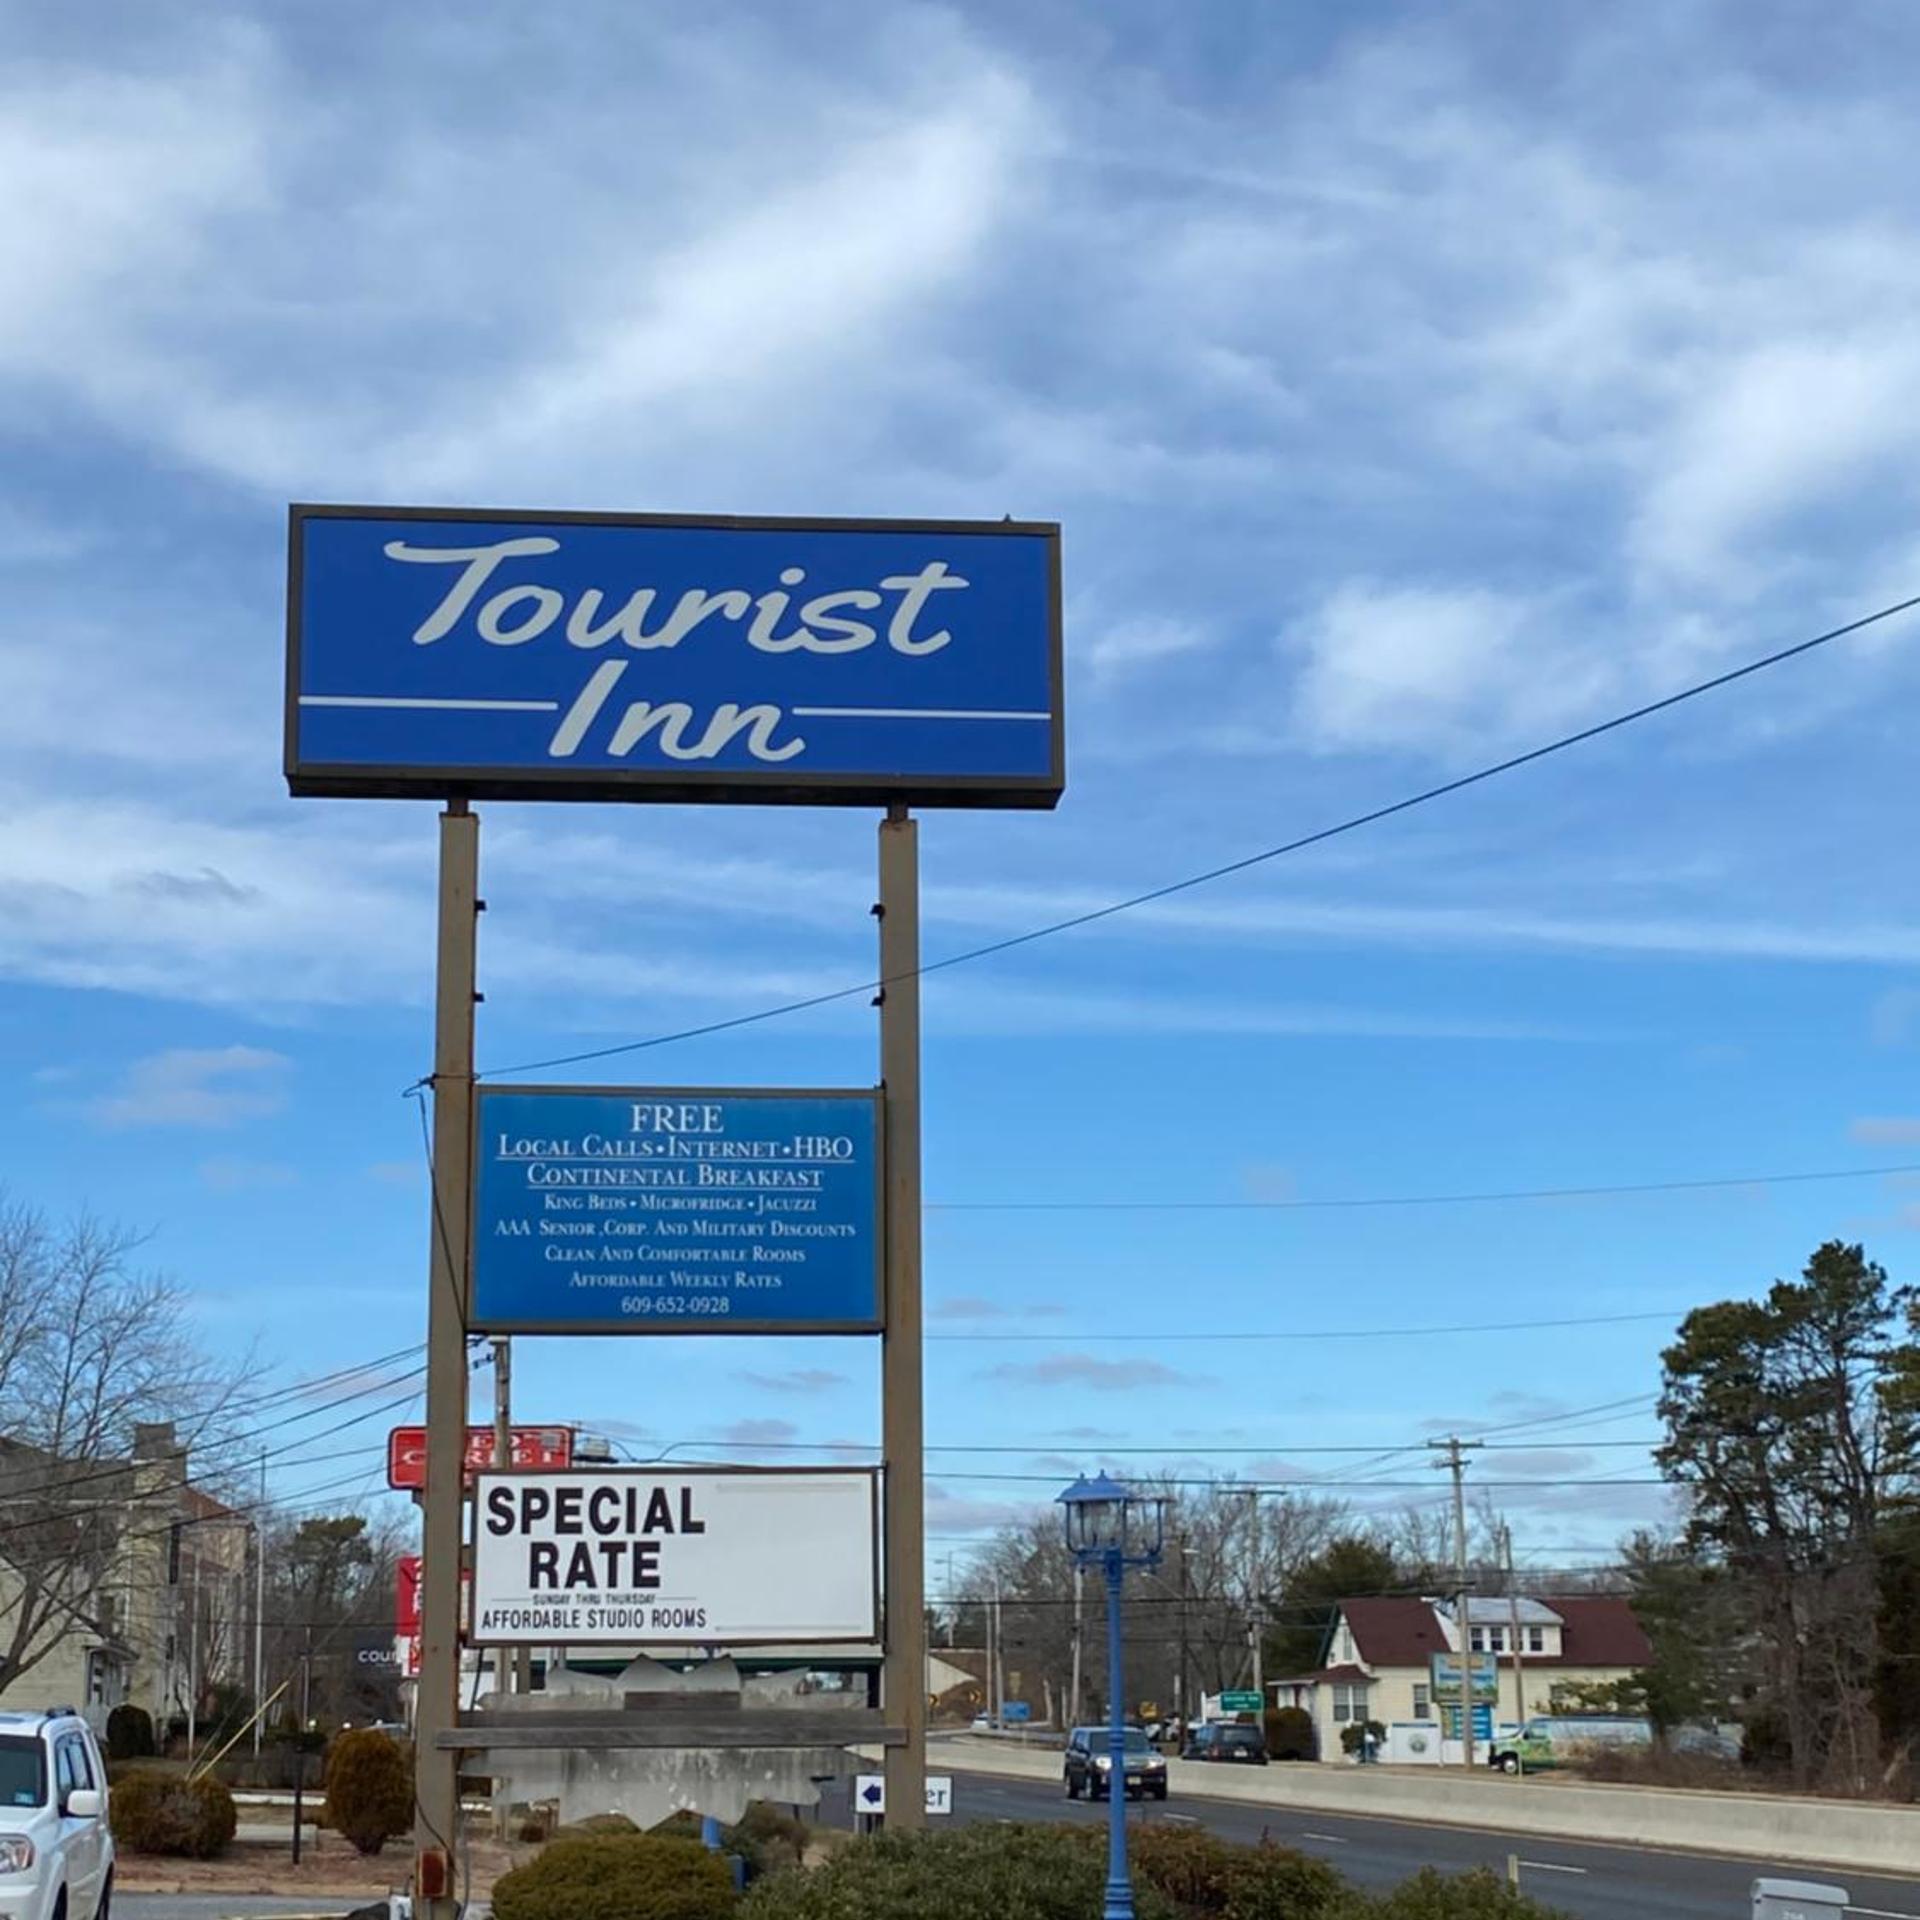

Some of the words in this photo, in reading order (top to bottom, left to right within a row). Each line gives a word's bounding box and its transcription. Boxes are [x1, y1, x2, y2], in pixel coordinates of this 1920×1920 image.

[384, 537, 969, 655] Tourist
[549, 659, 805, 761] Inn
[631, 1104, 724, 1133] FREE
[500, 1133, 576, 1156] LOCAL
[794, 1136, 854, 1158] HBO
[527, 1162, 691, 1185] CONTINENTAL
[698, 1163, 824, 1187] BREAKFAST
[692, 1219, 766, 1237] MILITARY
[771, 1219, 857, 1238] DISCOUNTS
[545, 1244, 596, 1262] CLEAN
[637, 1244, 747, 1262] COMFORTABLE
[752, 1245, 807, 1263] ROOMS
[569, 1270, 666, 1288] AFFORDABLE
[670, 1270, 730, 1288] WEEKLY
[735, 1270, 783, 1288] RATES
[621, 1295, 730, 1314] 609-652-0928
[486, 1486, 705, 1536] SPECIAL
[529, 1541, 661, 1589] RATE
[533, 1593, 571, 1606] SUNDAY
[606, 1593, 656, 1605] THURSDAY
[482, 1609, 581, 1629] AFFORDABLE
[587, 1608, 645, 1629] STUDIO
[651, 1608, 707, 1628] ROOMS
